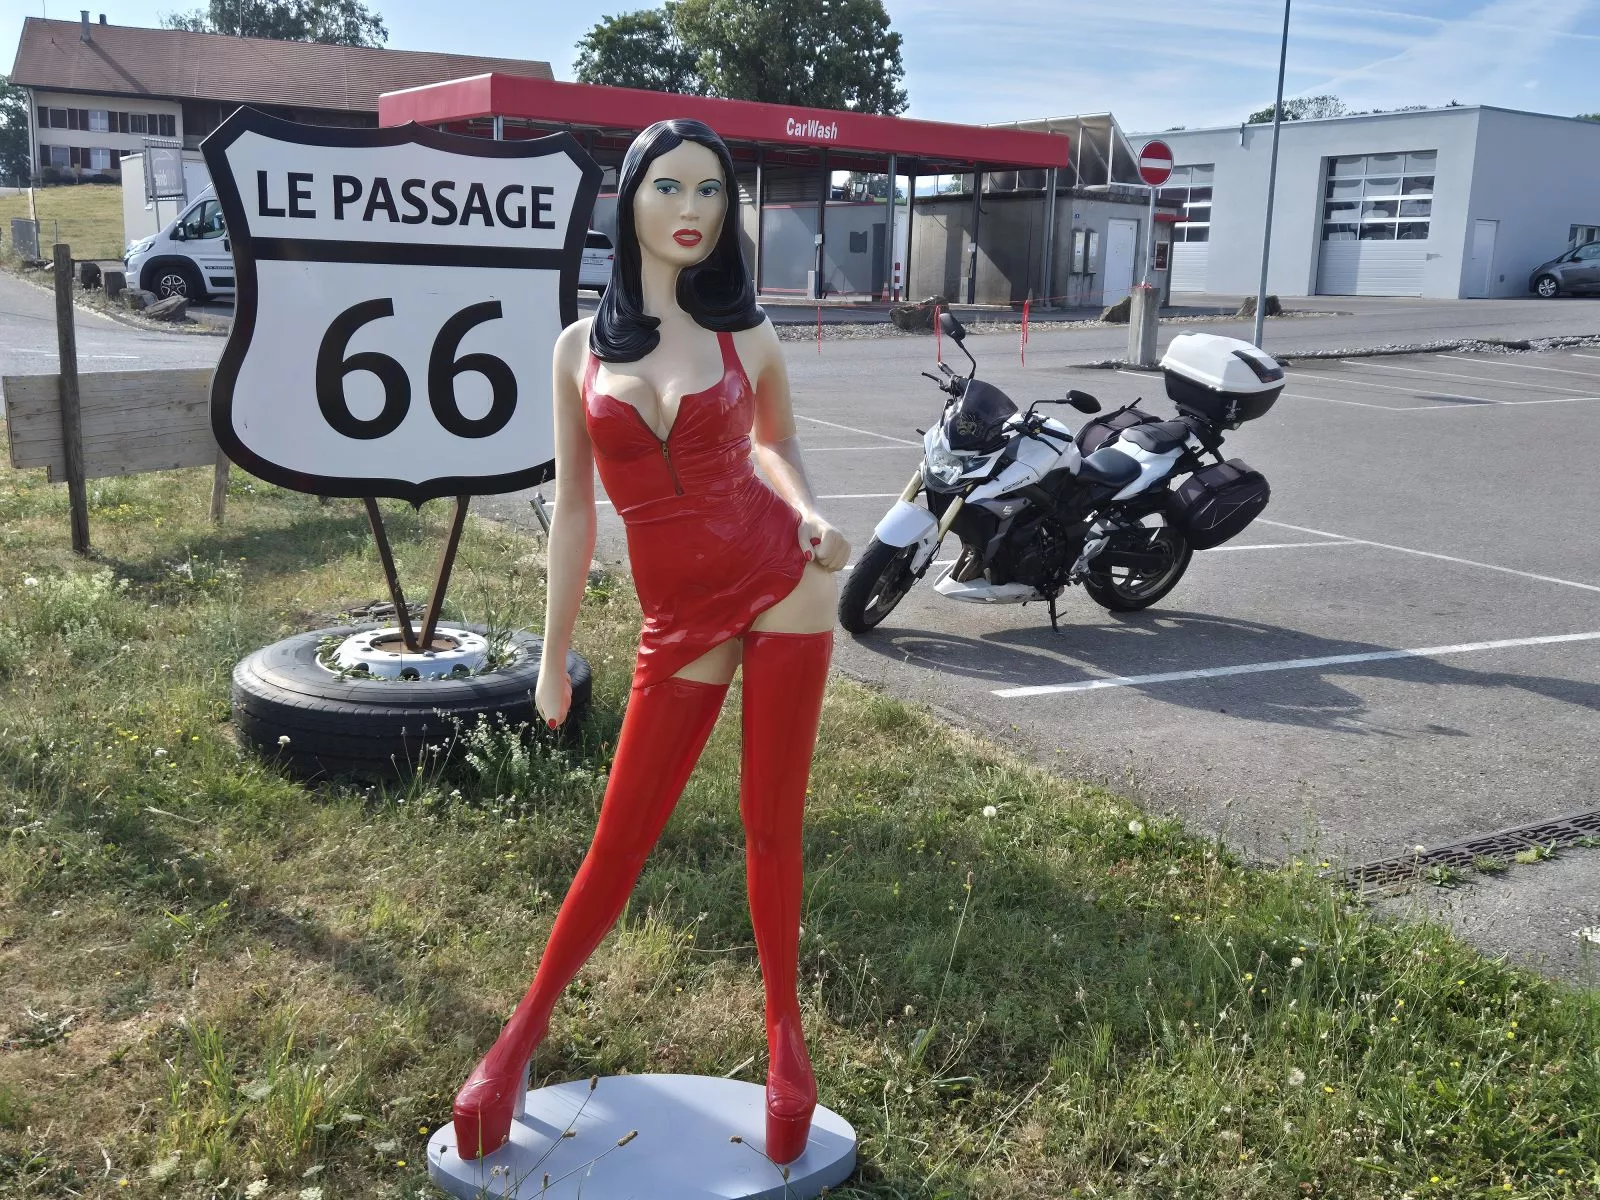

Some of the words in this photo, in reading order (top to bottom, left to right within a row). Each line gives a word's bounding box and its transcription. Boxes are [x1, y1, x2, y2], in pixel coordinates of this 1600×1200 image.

[786, 117, 838, 140] CarWash
[257, 170, 316, 219] LE
[333, 174, 556, 230] PASSAGE
[315, 297, 518, 440] 66
